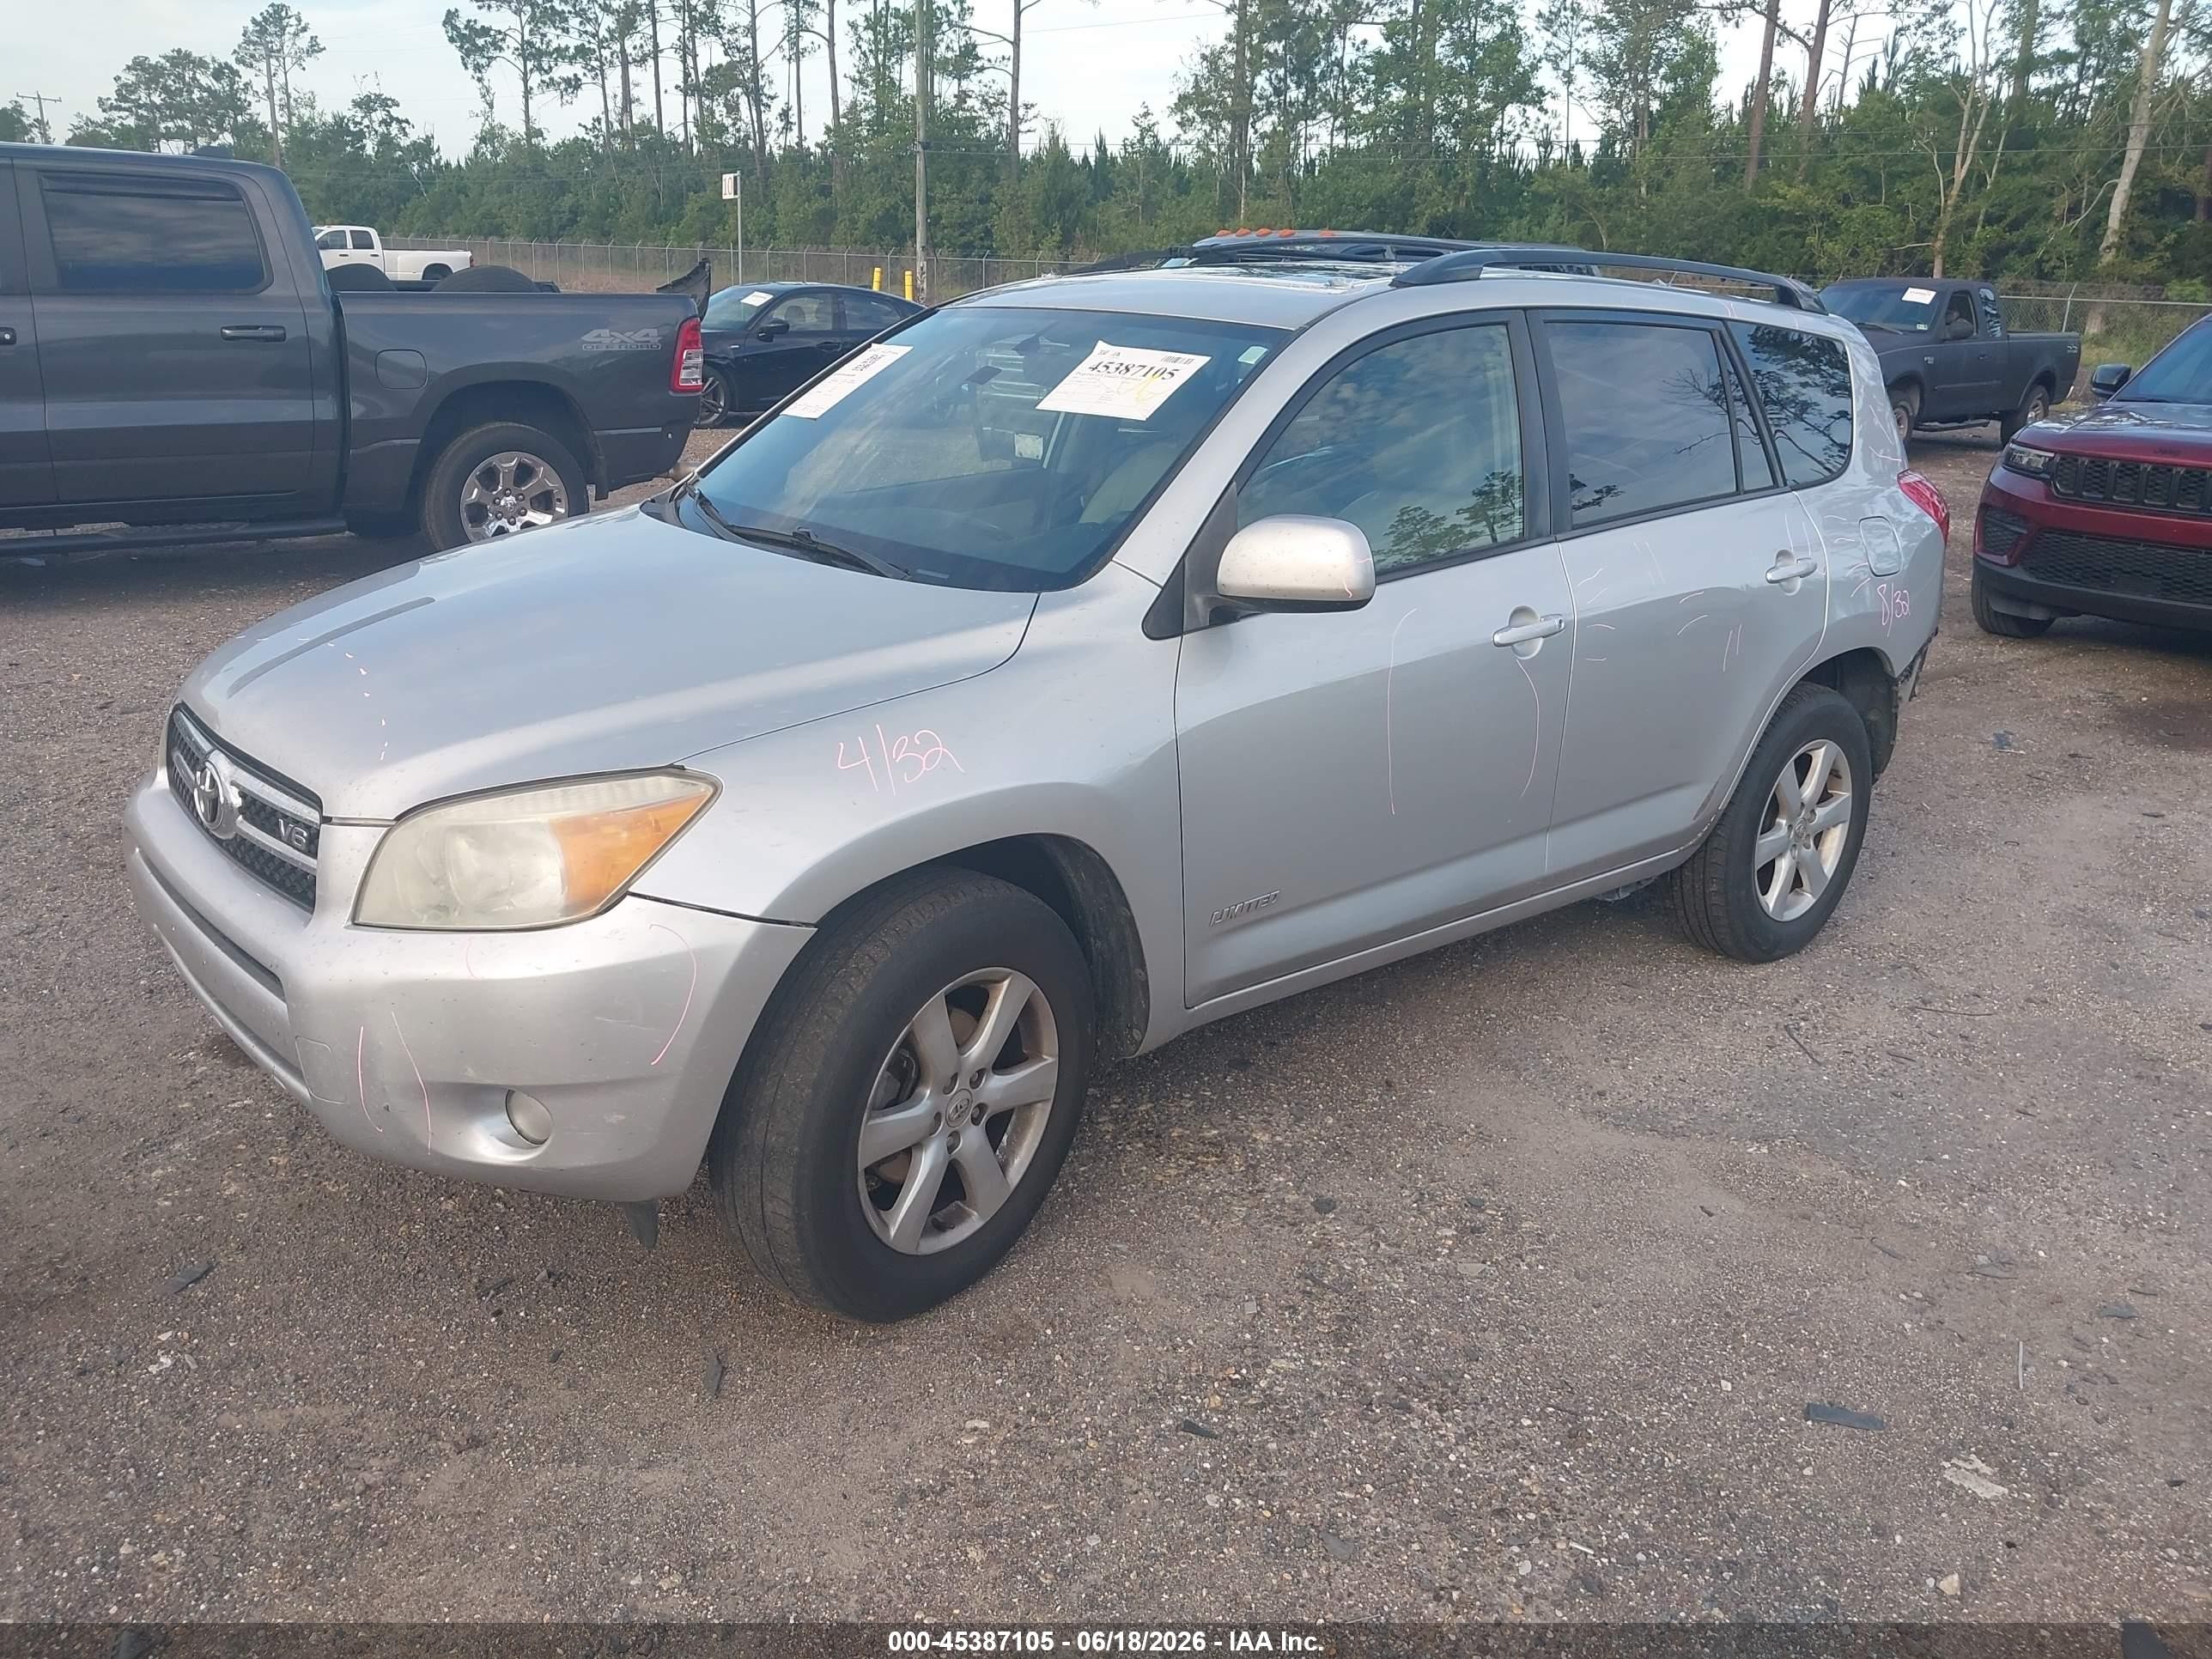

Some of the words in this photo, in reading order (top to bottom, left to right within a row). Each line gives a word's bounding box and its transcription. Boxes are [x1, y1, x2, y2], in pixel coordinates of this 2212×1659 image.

[724, 177, 733, 196] 10
[1088, 361, 1180, 380] 45387105
[837, 724, 966, 796] 4/32
[276, 818, 307, 850] V6
[1209, 890, 1280, 927] LIMITED
